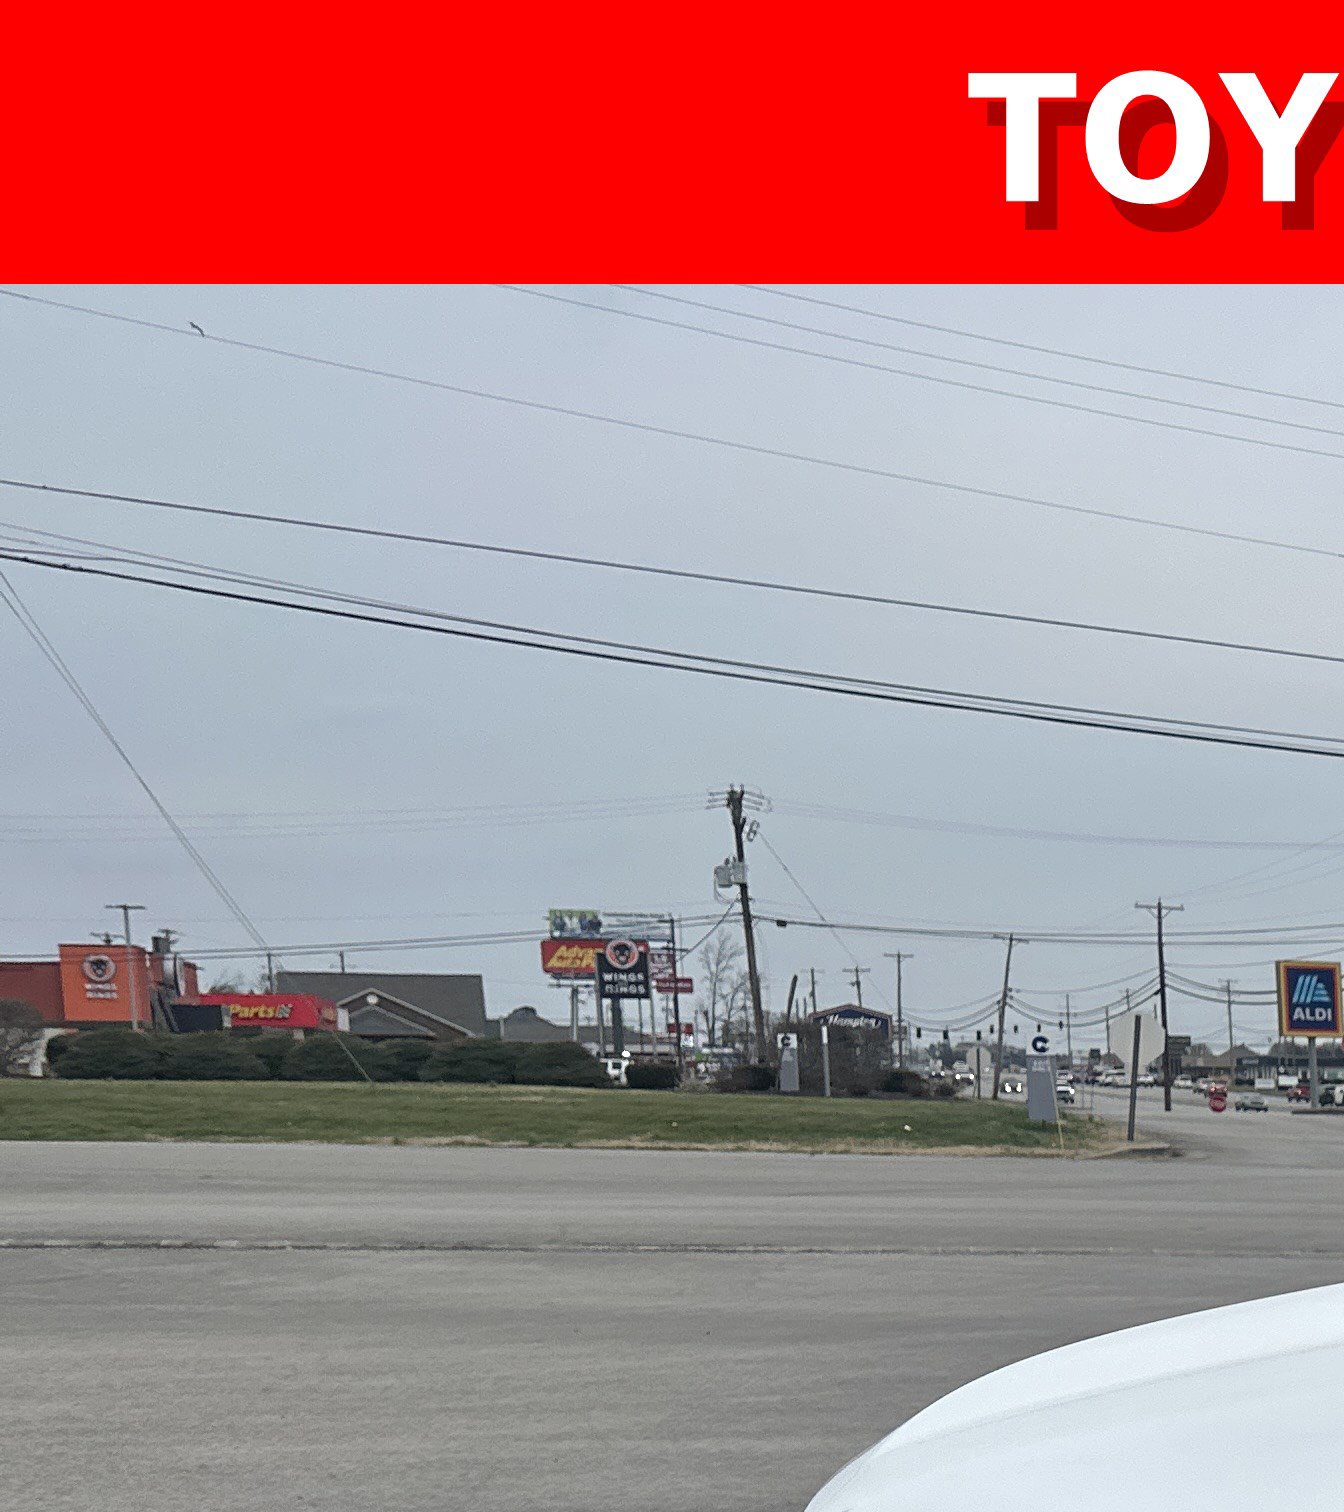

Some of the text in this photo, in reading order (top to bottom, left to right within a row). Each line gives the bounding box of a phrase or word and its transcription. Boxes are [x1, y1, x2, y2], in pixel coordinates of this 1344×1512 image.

[603, 972, 645, 982] WINGS
[229, 1003, 275, 1020] Parts
[1292, 1006, 1333, 1023] ALDI
